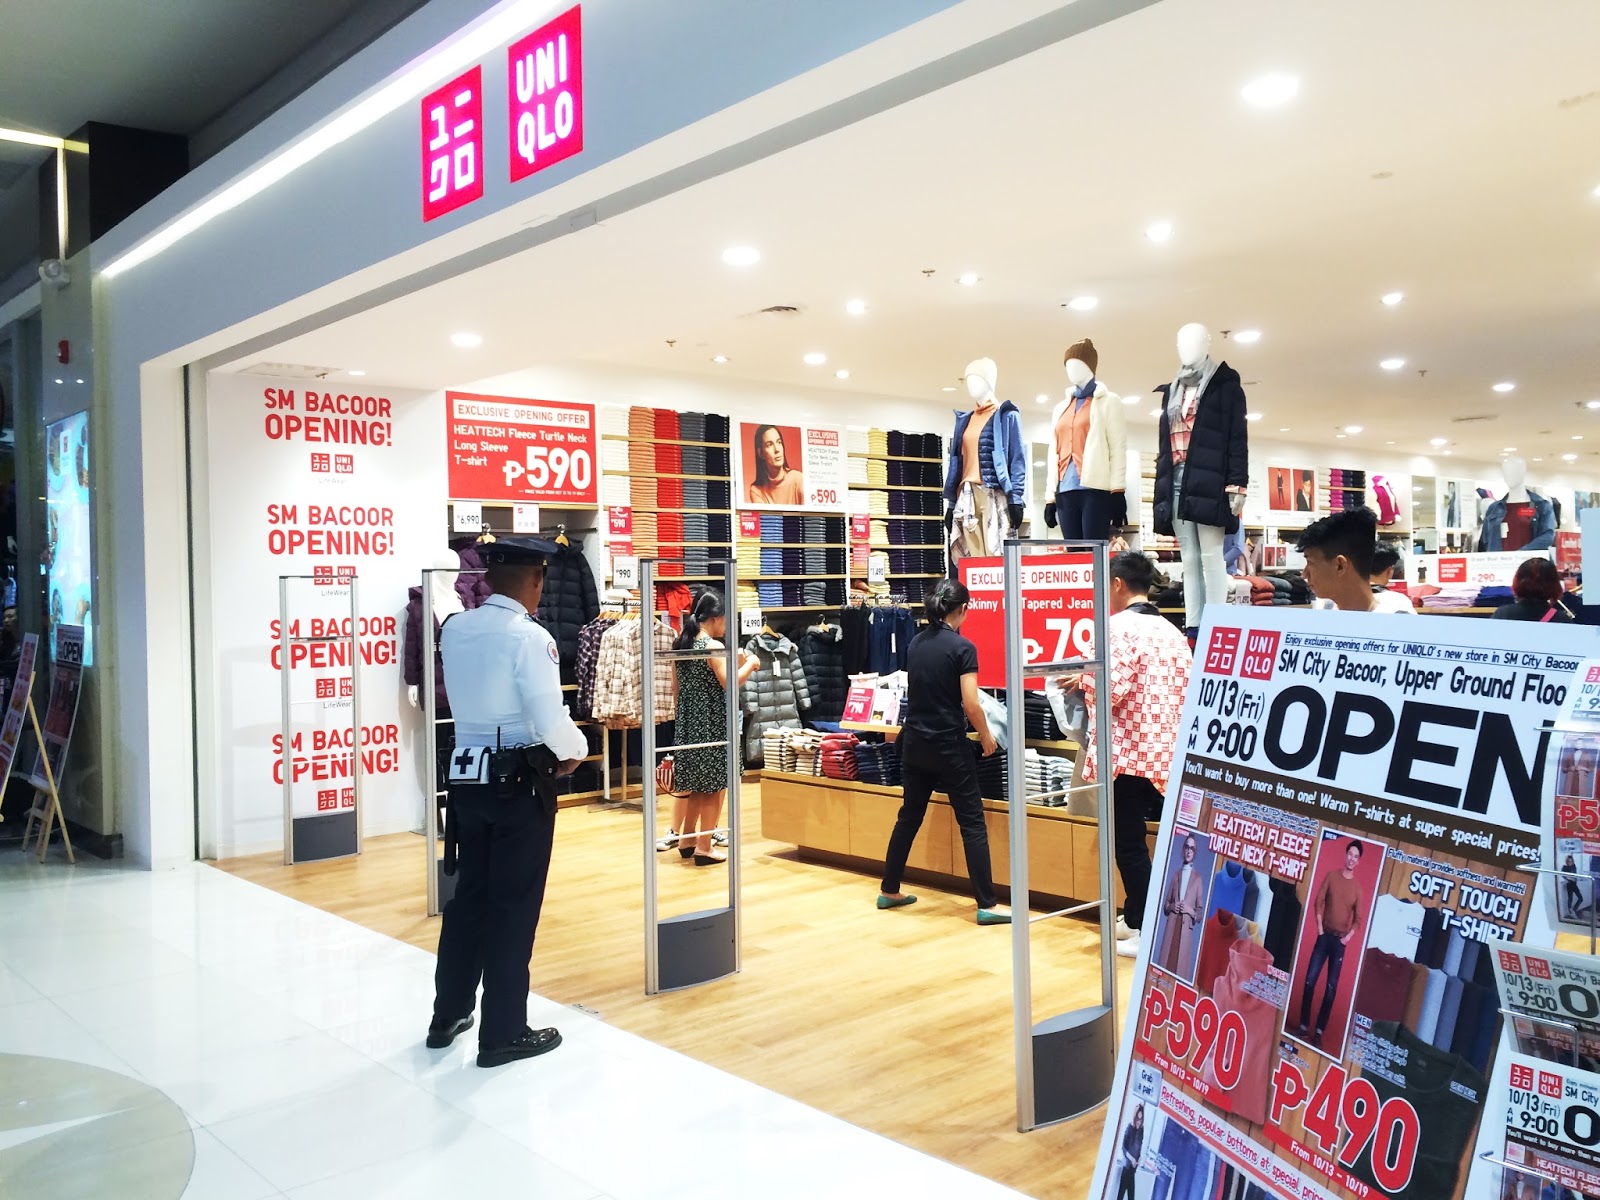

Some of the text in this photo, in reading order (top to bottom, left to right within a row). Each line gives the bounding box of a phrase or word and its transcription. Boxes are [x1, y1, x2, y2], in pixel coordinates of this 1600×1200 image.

[515, 33, 567, 104] UNI
[517, 91, 573, 165] QLO
[263, 387, 392, 418] SM BACOOR
[458, 404, 586, 424] EXCLUSIVE OPENING OFFER
[264, 413, 393, 447] OPENING!
[453, 424, 588, 444] HEATTECH Fleece Turtle Neck
[454, 439, 509, 453] Long Sleeve
[336, 456, 351, 464] UNI
[336, 464, 352, 473] QLO
[454, 454, 488, 467] T-shirt
[267, 504, 394, 526] SM BACOOR
[268, 529, 394, 556] OPENING!
[1031, 570, 1078, 584] OPENING
[967, 598, 999, 612] Skinny
[1022, 597, 1063, 612] Tapered
[1067, 597, 1094, 609] Jean
[270, 617, 396, 640] SM BACOOR
[64, 641, 83, 663] OPEN
[270, 640, 397, 670] OPENING!
[1249, 635, 1275, 654] UNI
[1285, 633, 1303, 647] Enjoy
[1304, 636, 1333, 648] exclusive
[1334, 639, 1360, 652] opening
[1362, 640, 1386, 652] offers
[1387, 642, 1399, 653] for
[1444, 650, 1462, 660] new
[1465, 650, 1489, 662] store
[1491, 651, 1500, 663] in
[1503, 652, 1518, 665] SM
[1521, 654, 1542, 670] City
[1244, 655, 1272, 676] QLO
[1278, 648, 1568, 706] SM City Bacoor, Upper Ground Floo
[272, 724, 399, 755] SM BACOOR
[1206, 717, 1258, 762] 9:00
[272, 748, 399, 785] OPENING!
[1263, 685, 1555, 828] OPEN
[1184, 759, 1541, 862] You'll want to buy more than one! Warm T-shirts at super special prices!
[1213, 812, 1267, 844] HEATTECH
[1266, 828, 1313, 859] FLEECE
[1208, 832, 1308, 882] TURTLE NECK T-SHIRT
[1387, 847, 1406, 864] Fluffy
[1406, 854, 1431, 869] material
[1431, 860, 1455, 876] provides
[1456, 868, 1481, 882] softness
[1483, 875, 1495, 886] and
[1409, 871, 1521, 924] SOFT TOUCH
[1440, 908, 1515, 944] T-SHIRT
[1267, 964, 1290, 982] WOMEN
[1528, 959, 1546, 968] UNI
[1529, 968, 1549, 977] QLO
[1552, 968, 1567, 979] SM
[1569, 971, 1587, 985] City
[1518, 991, 1558, 1012] 9:00
[1356, 1013, 1372, 1028] MEN
[1141, 1068, 1153, 1083] Grab
[1153, 1051, 1210, 1096] From 10/13 10/19
[1541, 1074, 1559, 1086] UNI
[1541, 1085, 1560, 1096] QLO
[1565, 1086, 1600, 1107] SM City
[1520, 1111, 1559, 1137] 9:00
[1161, 1085, 1300, 1188] Refreshing, popular bottoms at special
[1290, 1139, 1370, 1198] From 10/13 10/19
[1536, 1158, 1576, 1178] HEATTECH
